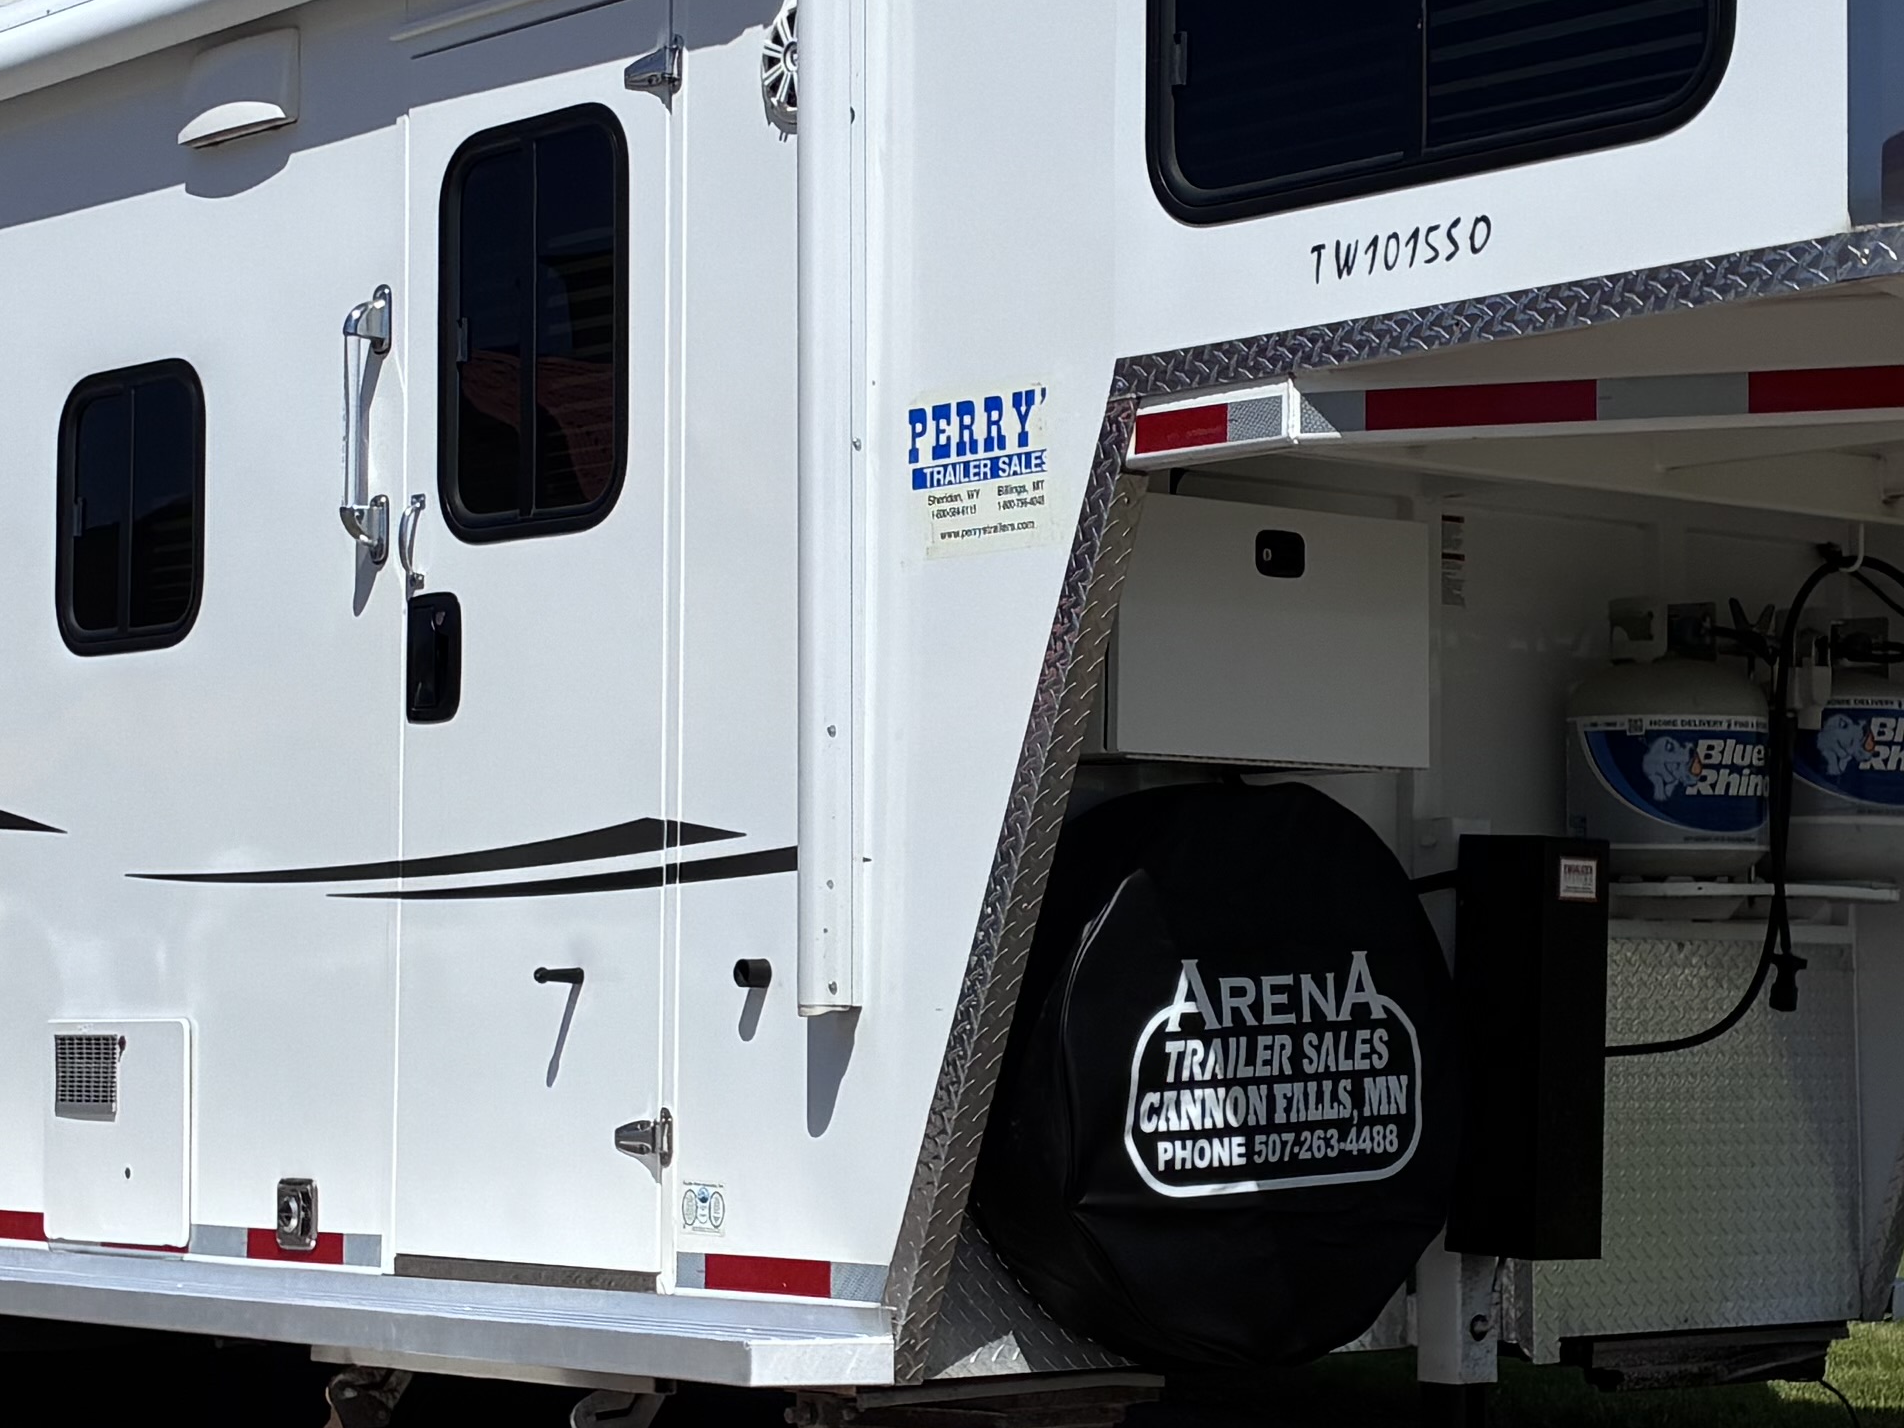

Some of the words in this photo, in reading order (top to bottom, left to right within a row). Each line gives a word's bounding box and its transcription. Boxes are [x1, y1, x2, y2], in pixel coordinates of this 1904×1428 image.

[923, 459, 991, 488] TRAILER
[1698, 738, 1765, 767] Blue
[1165, 950, 1387, 1032] ARENA
[1165, 1034, 1293, 1083] TRAILER
[1302, 1028, 1389, 1074] SALES
[1139, 1084, 1268, 1133] CANNON
[1273, 1079, 1359, 1124] FALLS,
[1363, 1075, 1408, 1117] MN
[1157, 1136, 1247, 1171] PHONE
[1253, 1124, 1399, 1164] 507-263-4488
